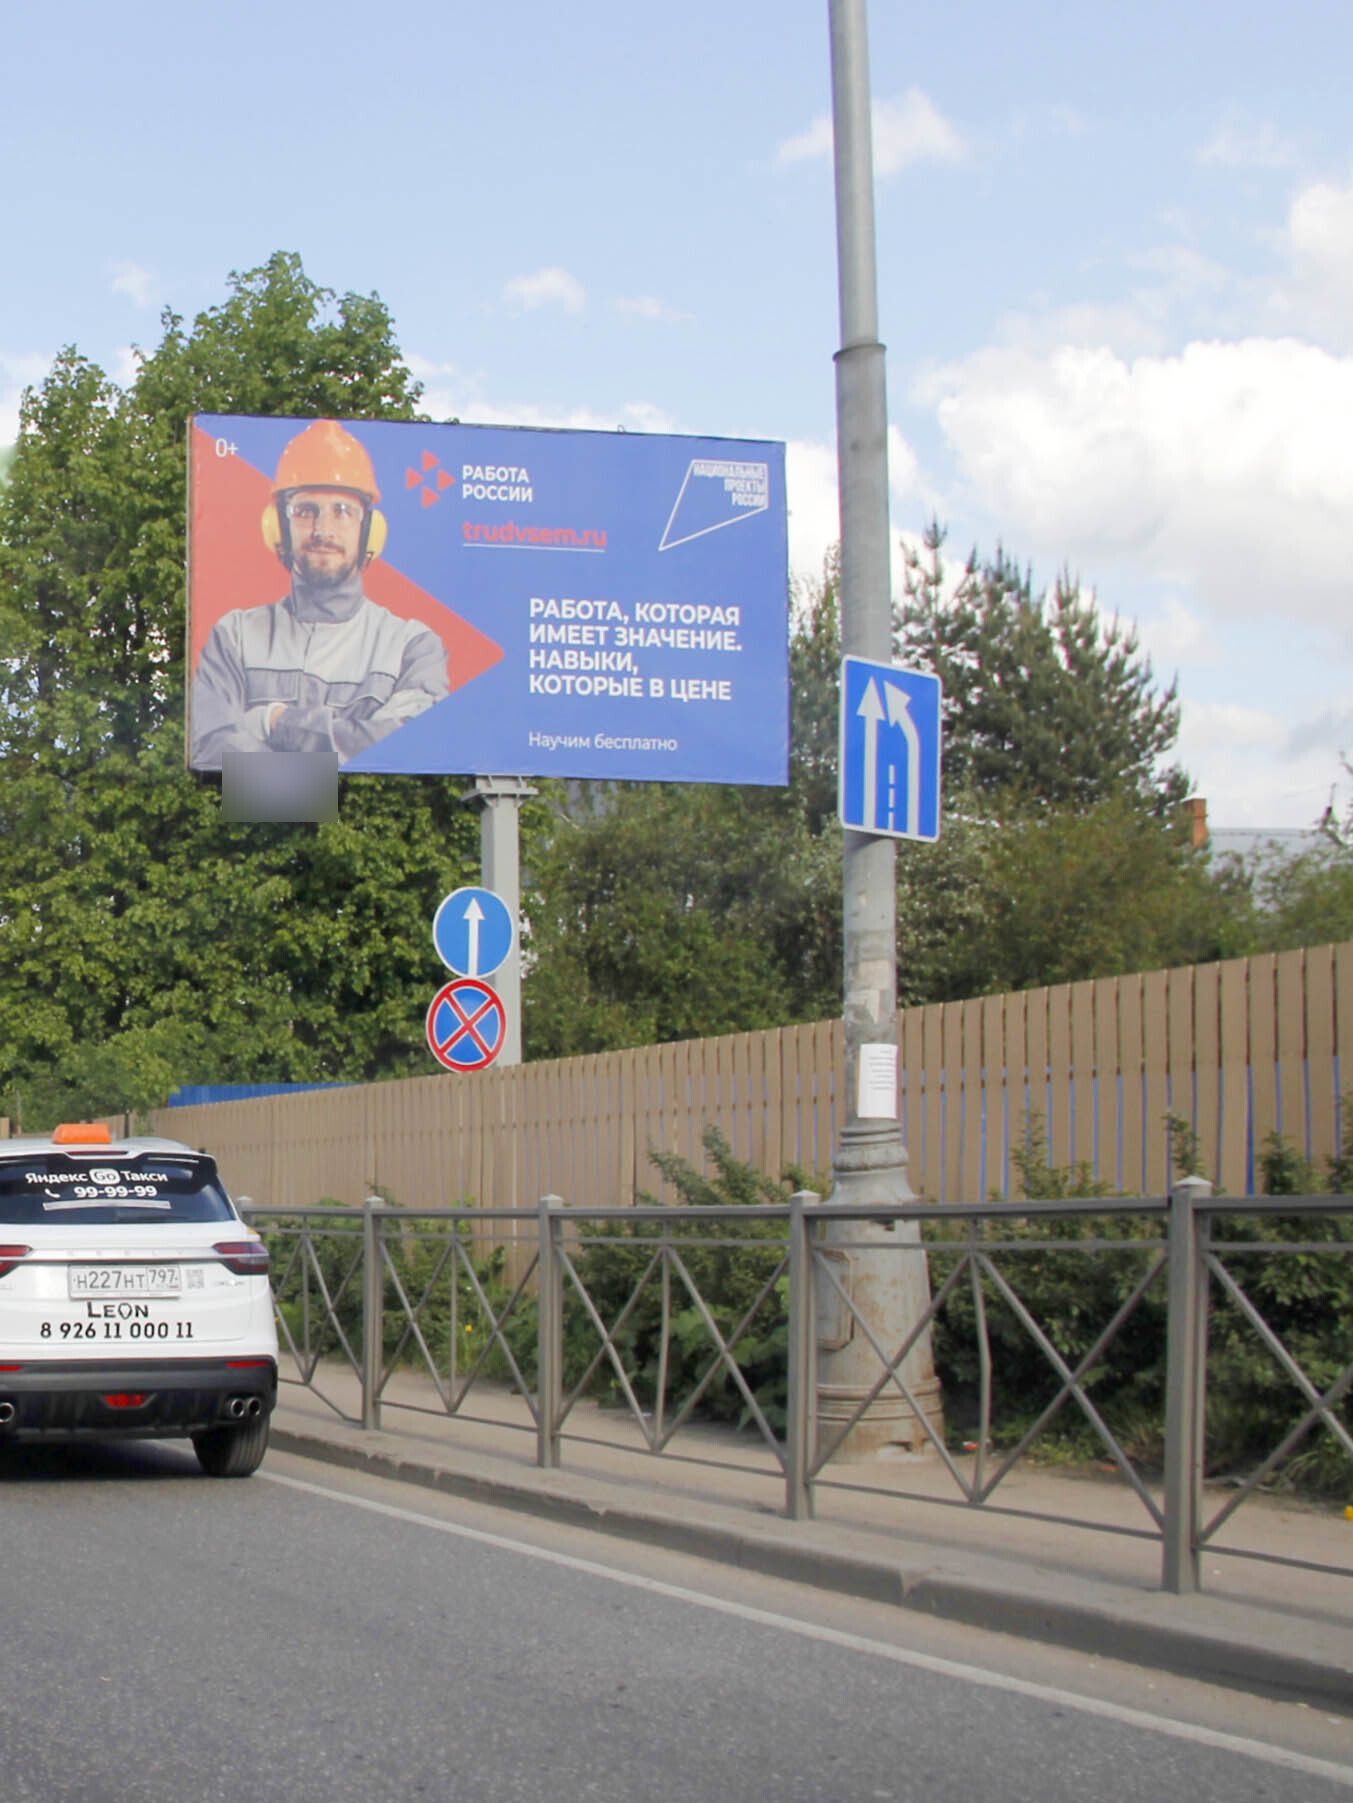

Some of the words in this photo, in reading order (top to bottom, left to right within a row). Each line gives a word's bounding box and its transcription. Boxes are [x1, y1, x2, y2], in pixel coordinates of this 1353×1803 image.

[215, 438, 239, 457] 0+
[462, 465, 529, 484] РАБОТА
[462, 485, 533, 503] РОССИИ
[732, 491, 767, 506] РОССИИ
[463, 521, 607, 547] trudvsem.ru
[530, 598, 629, 624] РАБОТА,
[635, 603, 740, 626] КОТОРАЯ
[530, 624, 609, 646] ИМЕЕТ
[614, 627, 742, 651] ЗНАЧЕНИЕ.
[530, 650, 639, 674] НАВЫКИ,
[530, 675, 643, 698] КОТОРЫЕ
[650, 679, 664, 698] В
[671, 680, 731, 702] ЦЕНЕ
[528, 732, 590, 751] Научим
[594, 733, 678, 752] бесплатно
[25, 1172, 88, 1184] Яндекс
[121, 1171, 168, 1182] Такси
[74, 1186, 158, 1198] 99-99-99
[149, 1270, 176, 1284] 797
[40, 1322, 52, 1338] 8
[59, 1322, 96, 1339] 926
[104, 1322, 121, 1339] 11
[130, 1322, 168, 1339] 000
[176, 1322, 193, 1338] 11
